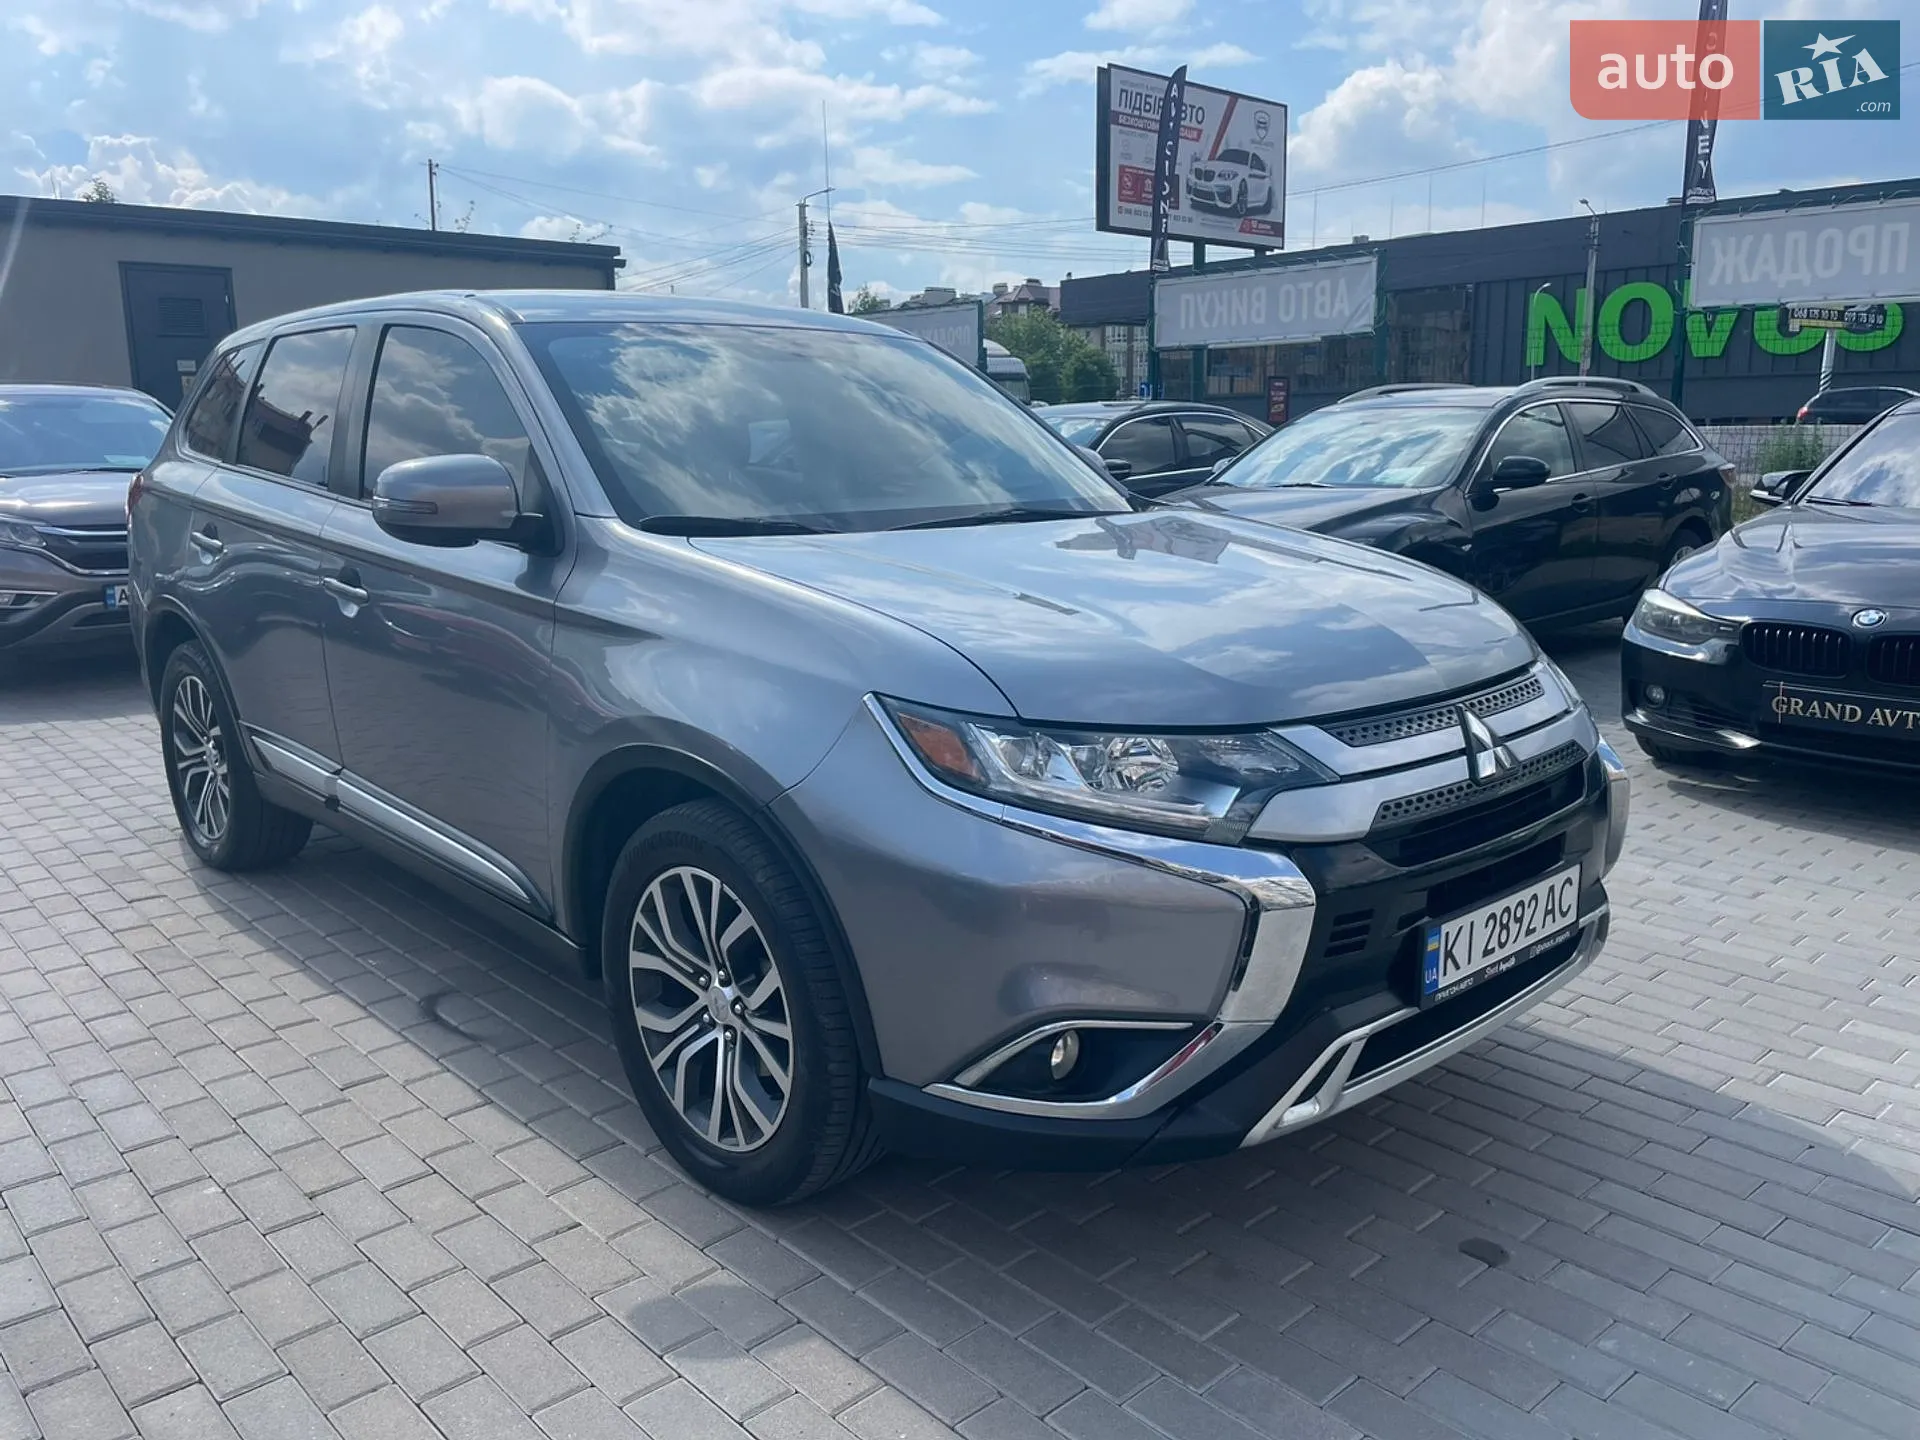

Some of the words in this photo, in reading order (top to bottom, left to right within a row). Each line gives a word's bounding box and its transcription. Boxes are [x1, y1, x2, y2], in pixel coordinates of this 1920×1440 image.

[1180, 103, 1205, 125] ВТО
[1771, 696, 1862, 723] GRAND
[1867, 706, 1920, 730] AVT
[1442, 920, 1475, 977] KI
[1482, 892, 1539, 959] 2892
[1542, 876, 1573, 929] AC
[1425, 967, 1438, 984] UA
